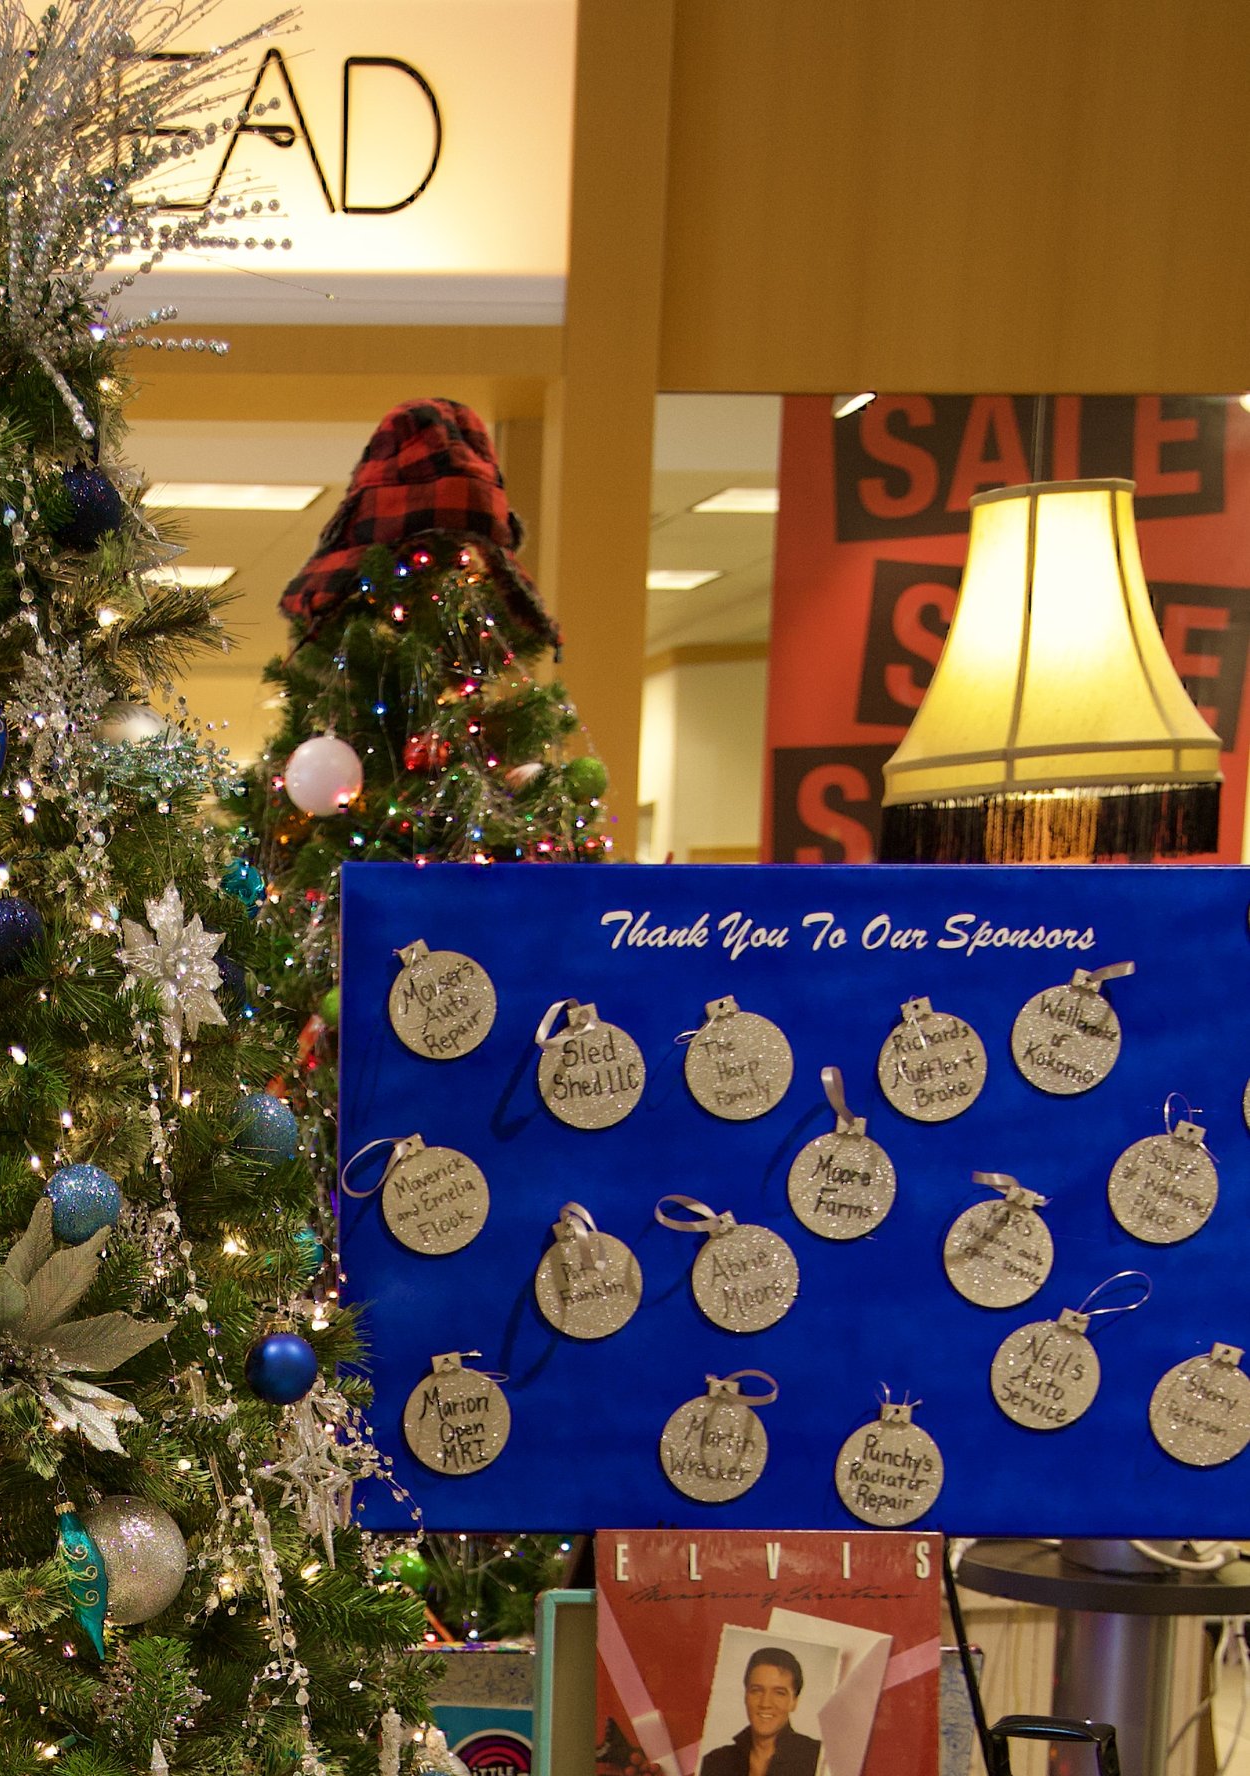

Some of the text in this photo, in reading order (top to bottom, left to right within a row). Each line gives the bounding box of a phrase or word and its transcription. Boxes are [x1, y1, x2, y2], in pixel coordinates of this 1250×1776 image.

[884, 582, 1230, 738] SE
[601, 911, 1097, 960] Thank You To Our Sponsors
[425, 994, 470, 1024] Auto
[422, 1008, 481, 1056] Repair
[561, 1031, 616, 1067] Sled
[553, 1063, 640, 1101] Shed LLC
[393, 1155, 466, 1199] Maverick
[810, 1154, 872, 1187] Moore
[397, 1204, 421, 1222] and
[813, 1187, 872, 1219] Farms
[1019, 1332, 1087, 1383] Neil's
[1011, 1366, 1066, 1402] Auto
[418, 1384, 490, 1421] Marion
[439, 1421, 486, 1445] Open
[854, 1482, 915, 1512] Repair
[615, 1541, 931, 1582] ELVIS
